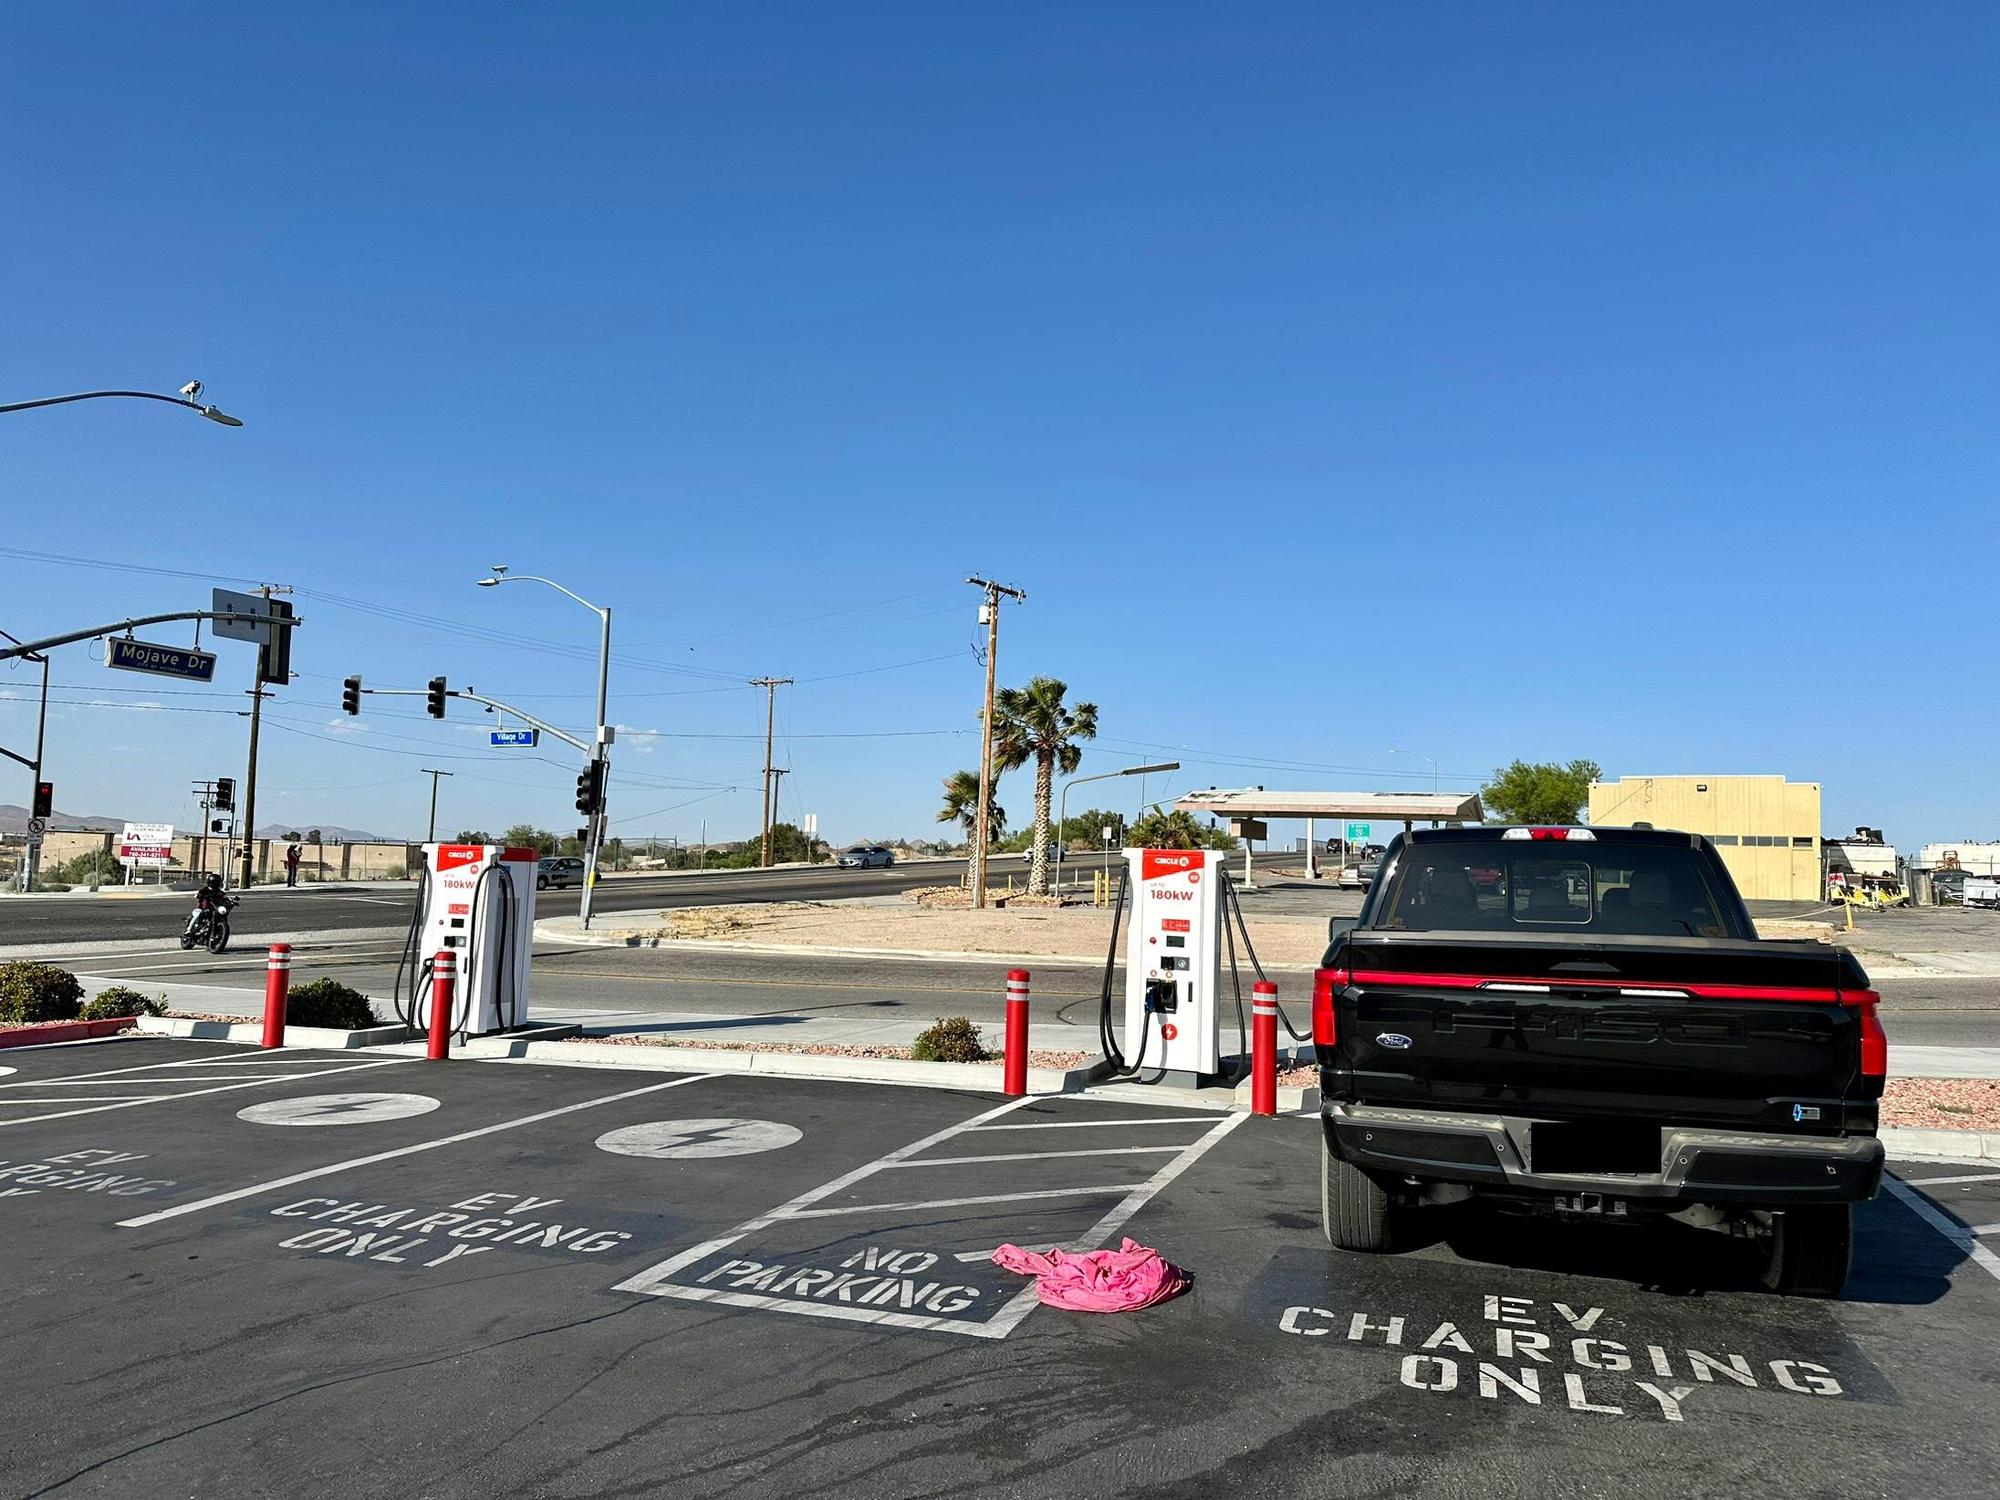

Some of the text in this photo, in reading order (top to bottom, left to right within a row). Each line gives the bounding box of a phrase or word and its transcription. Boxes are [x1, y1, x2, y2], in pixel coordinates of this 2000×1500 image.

[121, 645, 207, 669] Mojave Dr
[496, 733, 516, 743] Village
[518, 732, 526, 740] Dr
[1154, 857, 1178, 865] CIRCLE
[443, 880, 475, 889] 180kW
[1150, 890, 1193, 900] 180kW
[1382, 1034, 1408, 1047] Ford
[42, 1149, 150, 1167] EV
[450, 1192, 564, 1214] EV
[270, 1198, 632, 1253] CHARGING
[278, 1228, 495, 1268] ONLY
[839, 1247, 938, 1274] NO
[696, 1259, 980, 1313] PARKING
[1484, 1295, 1604, 1331] EV
[1278, 1306, 1844, 1395] CHARGING
[1400, 1354, 1694, 1421] ONLY
